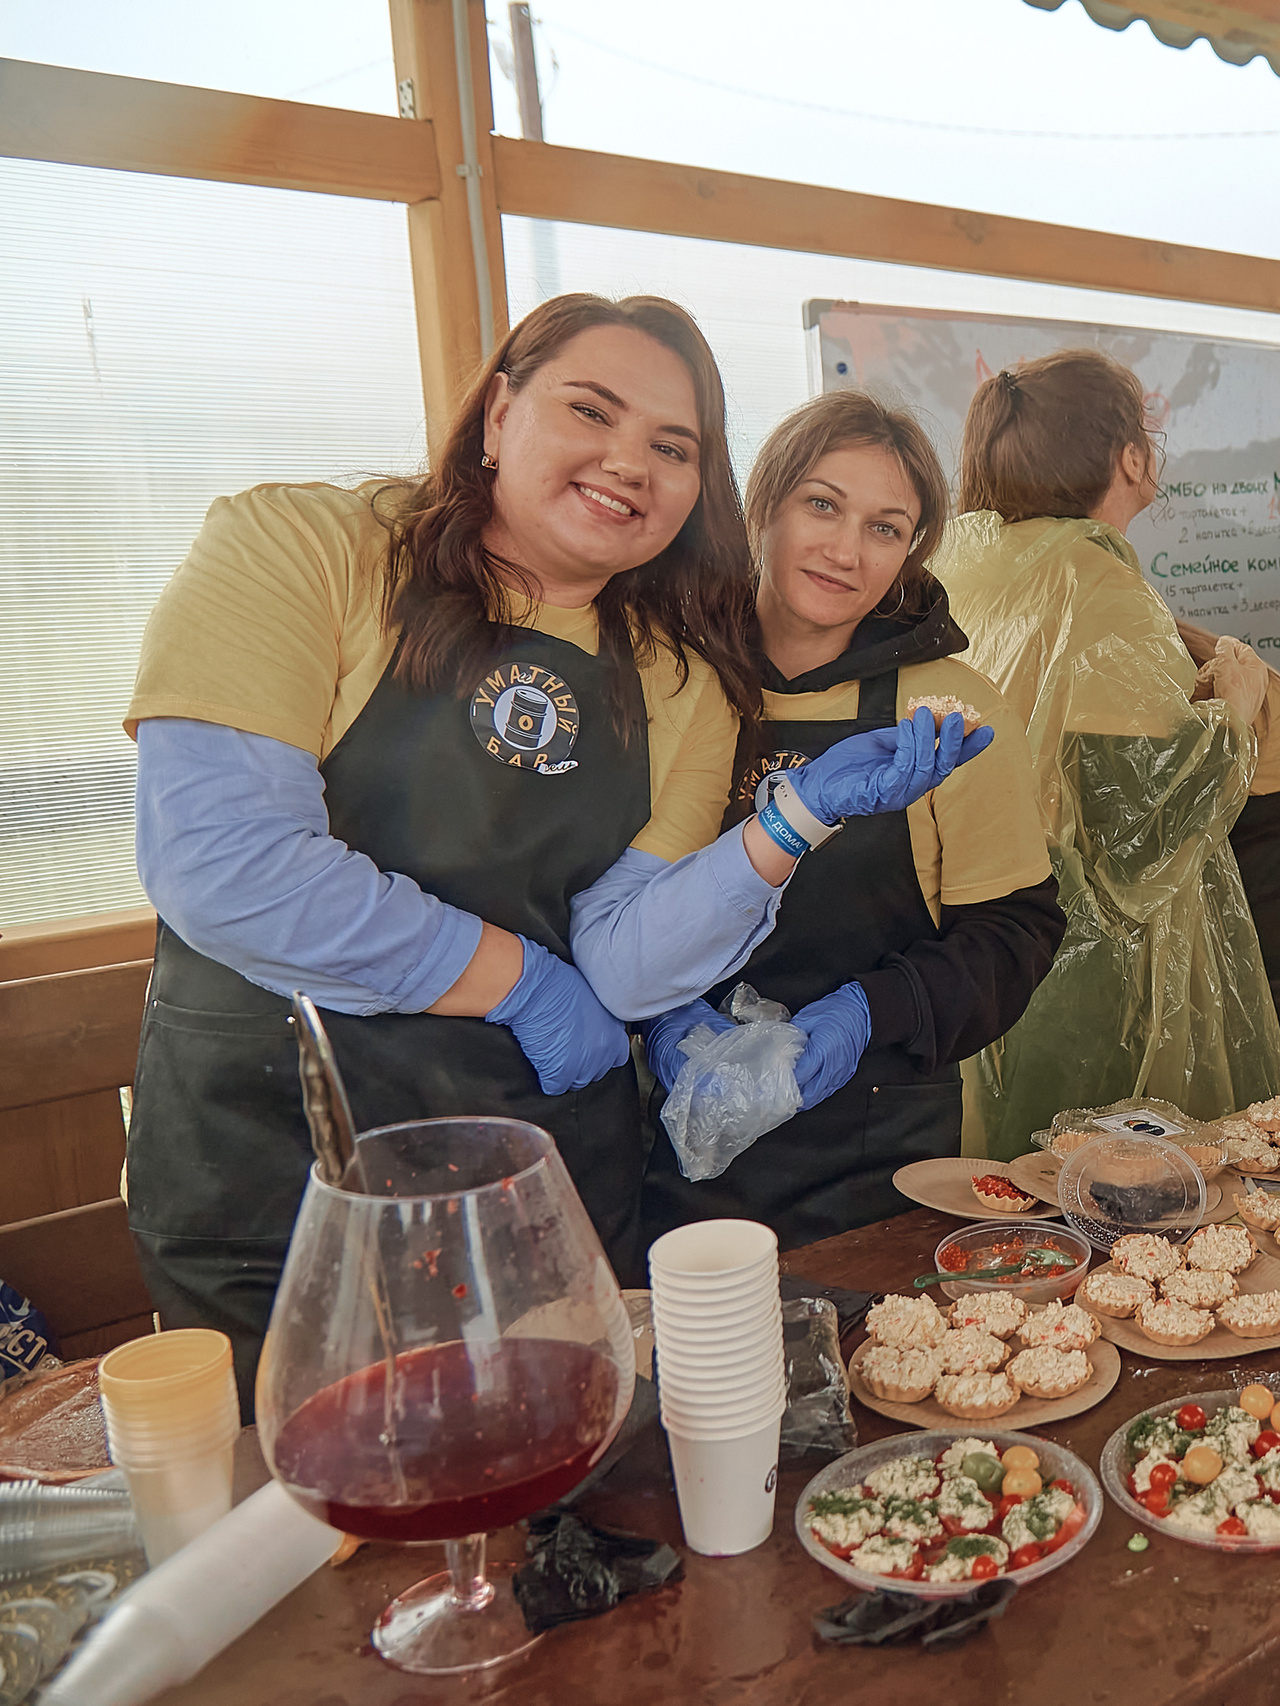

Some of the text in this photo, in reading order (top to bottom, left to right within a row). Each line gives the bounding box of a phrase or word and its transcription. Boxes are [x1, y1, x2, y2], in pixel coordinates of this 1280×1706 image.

[1156, 481, 1207, 499] ОМБО
[1178, 527, 1189, 544] 2
[1151, 552, 1239, 577] Семейное
